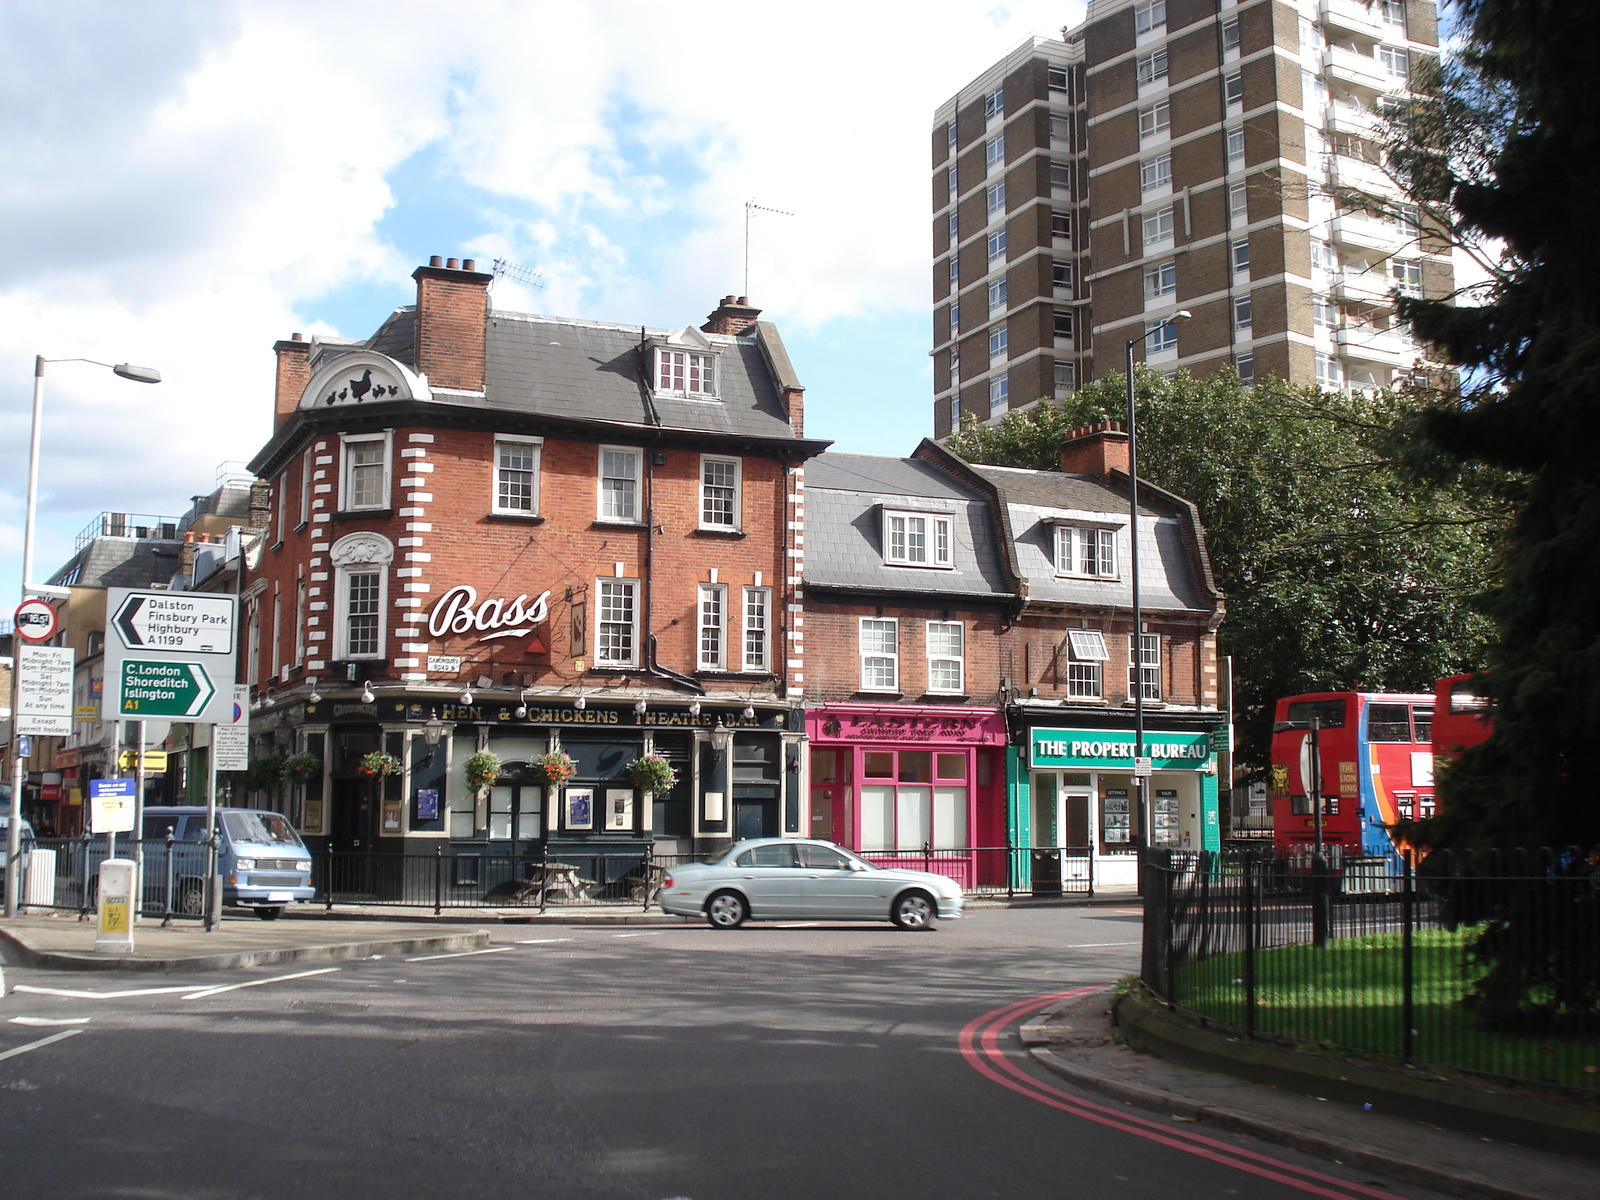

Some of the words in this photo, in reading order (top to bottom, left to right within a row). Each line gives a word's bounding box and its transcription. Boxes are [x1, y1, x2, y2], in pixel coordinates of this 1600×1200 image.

[149, 599, 194, 611] Dalston
[429, 585, 551, 638] Bass
[148, 611, 198, 625] Finsbury
[202, 614, 228, 625] Park
[148, 623, 200, 637] Highbury
[125, 676, 188, 689] Shoreditch
[124, 688, 176, 701] Islington
[35, 703, 48, 711] any
[124, 700, 139, 710] A1
[32, 717, 57, 725] Except
[442, 704, 482, 720] HEN
[498, 707, 510, 720] &
[528, 706, 619, 725] CHICKENS
[632, 710, 712, 726] THEATRE
[725, 712, 760, 727] BAR
[850, 715, 980, 731] EASTERN
[43, 726, 70, 734] holders
[1038, 740, 1067, 756] THE
[1152, 744, 1206, 759] BUREAU
[1341, 765, 1354, 773] THE
[1340, 774, 1356, 782] LION
[1340, 784, 1357, 792] KING
